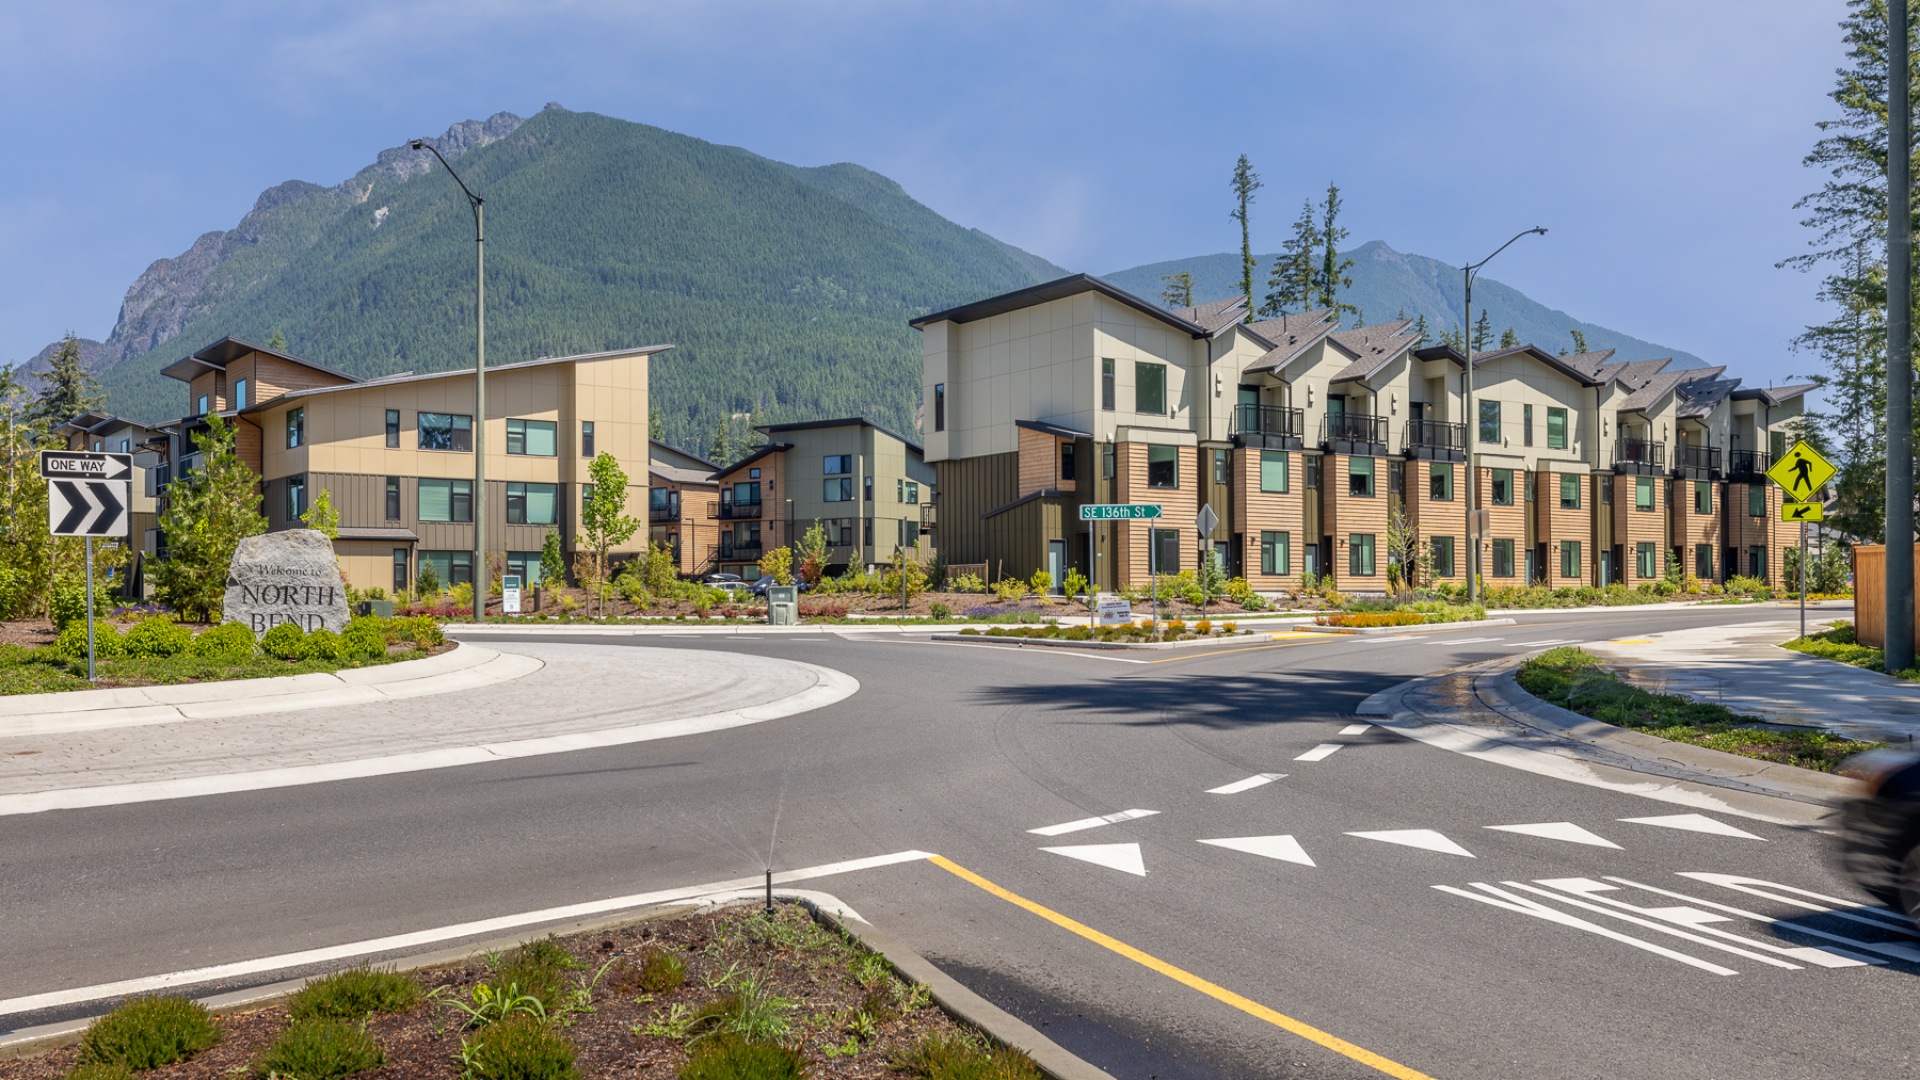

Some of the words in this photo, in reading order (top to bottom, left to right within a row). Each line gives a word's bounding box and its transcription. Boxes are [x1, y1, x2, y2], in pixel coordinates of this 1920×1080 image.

[51, 459, 76, 471] ONE
[80, 461, 105, 472] WAY
[1084, 506, 1098, 518] SE
[1102, 506, 1131, 518] 136th
[1134, 506, 1146, 517] St
[258, 564, 307, 577] Welcome
[311, 569, 322, 577] to
[241, 584, 335, 606] NORTH
